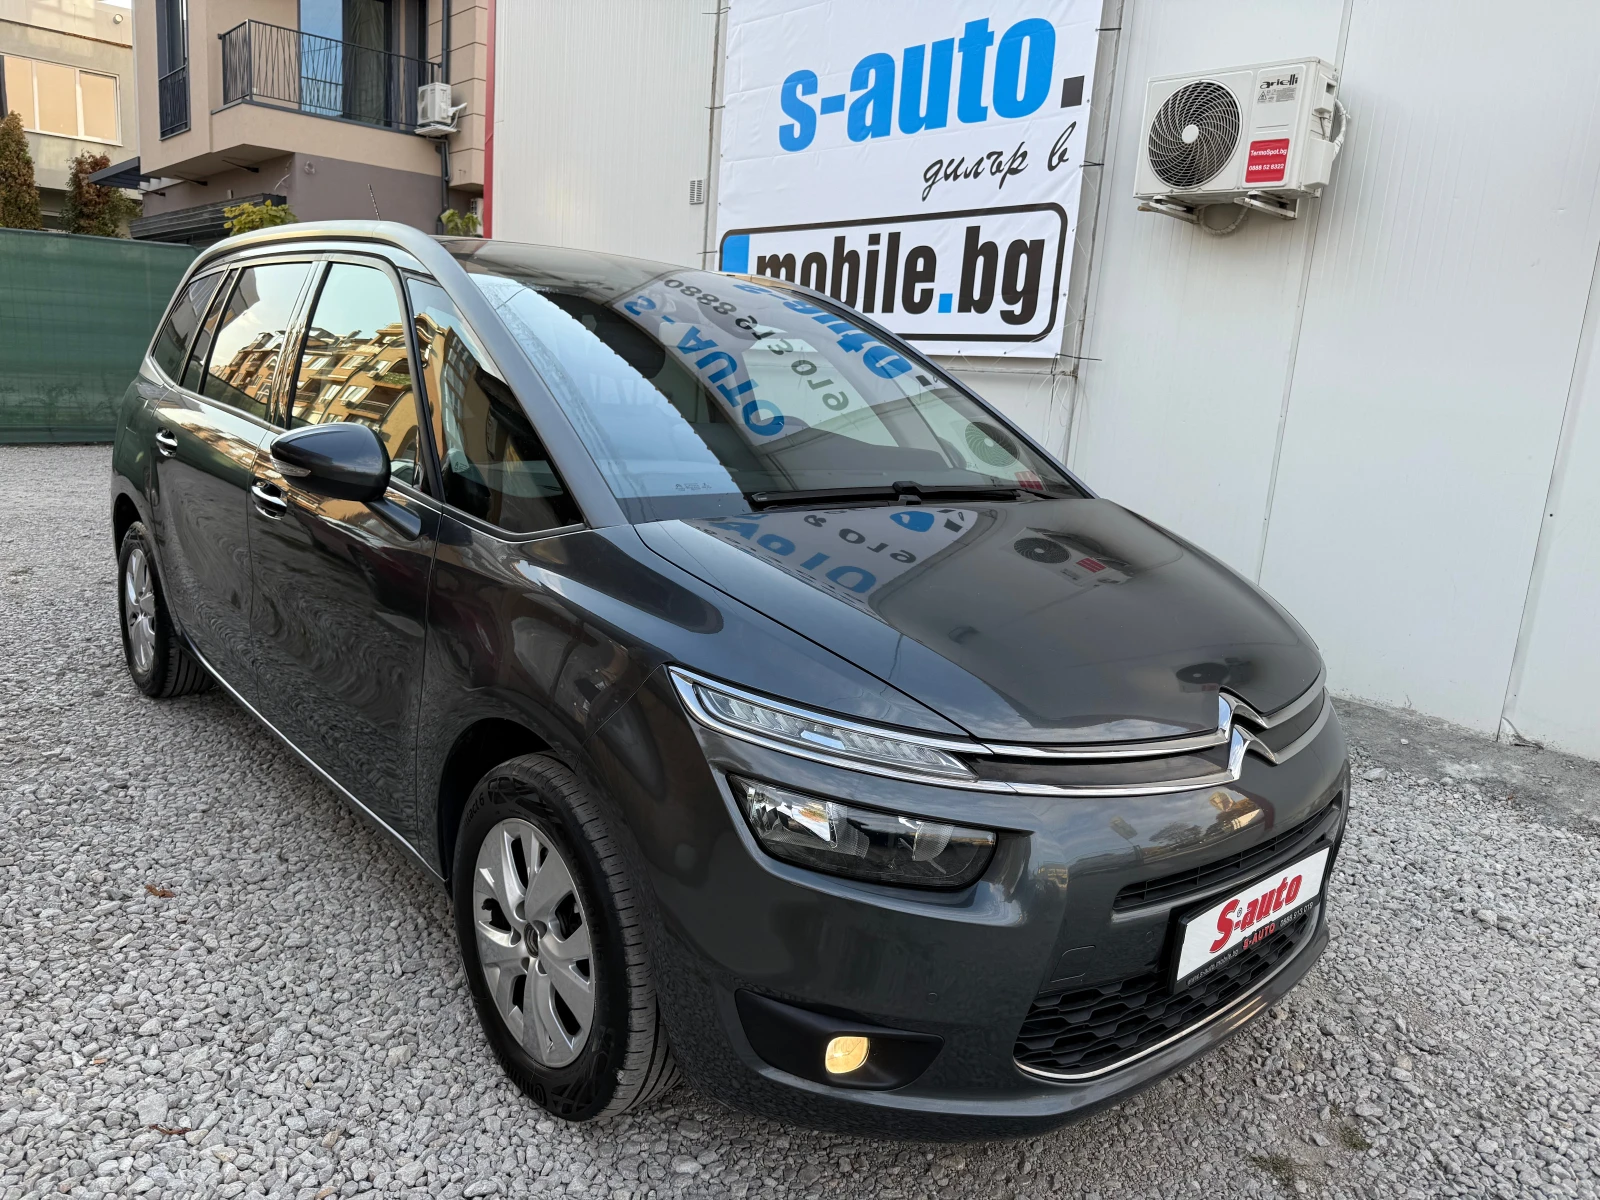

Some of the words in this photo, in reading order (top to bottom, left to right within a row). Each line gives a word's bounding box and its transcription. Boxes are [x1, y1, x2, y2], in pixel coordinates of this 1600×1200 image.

[1260, 74, 1298, 89] arielli
[922, 141, 1029, 202] дилър
[1047, 121, 1077, 172] в
[1250, 148, 1287, 157] TermoSpot.bg
[1243, 922, 1276, 950] S-AUTO
